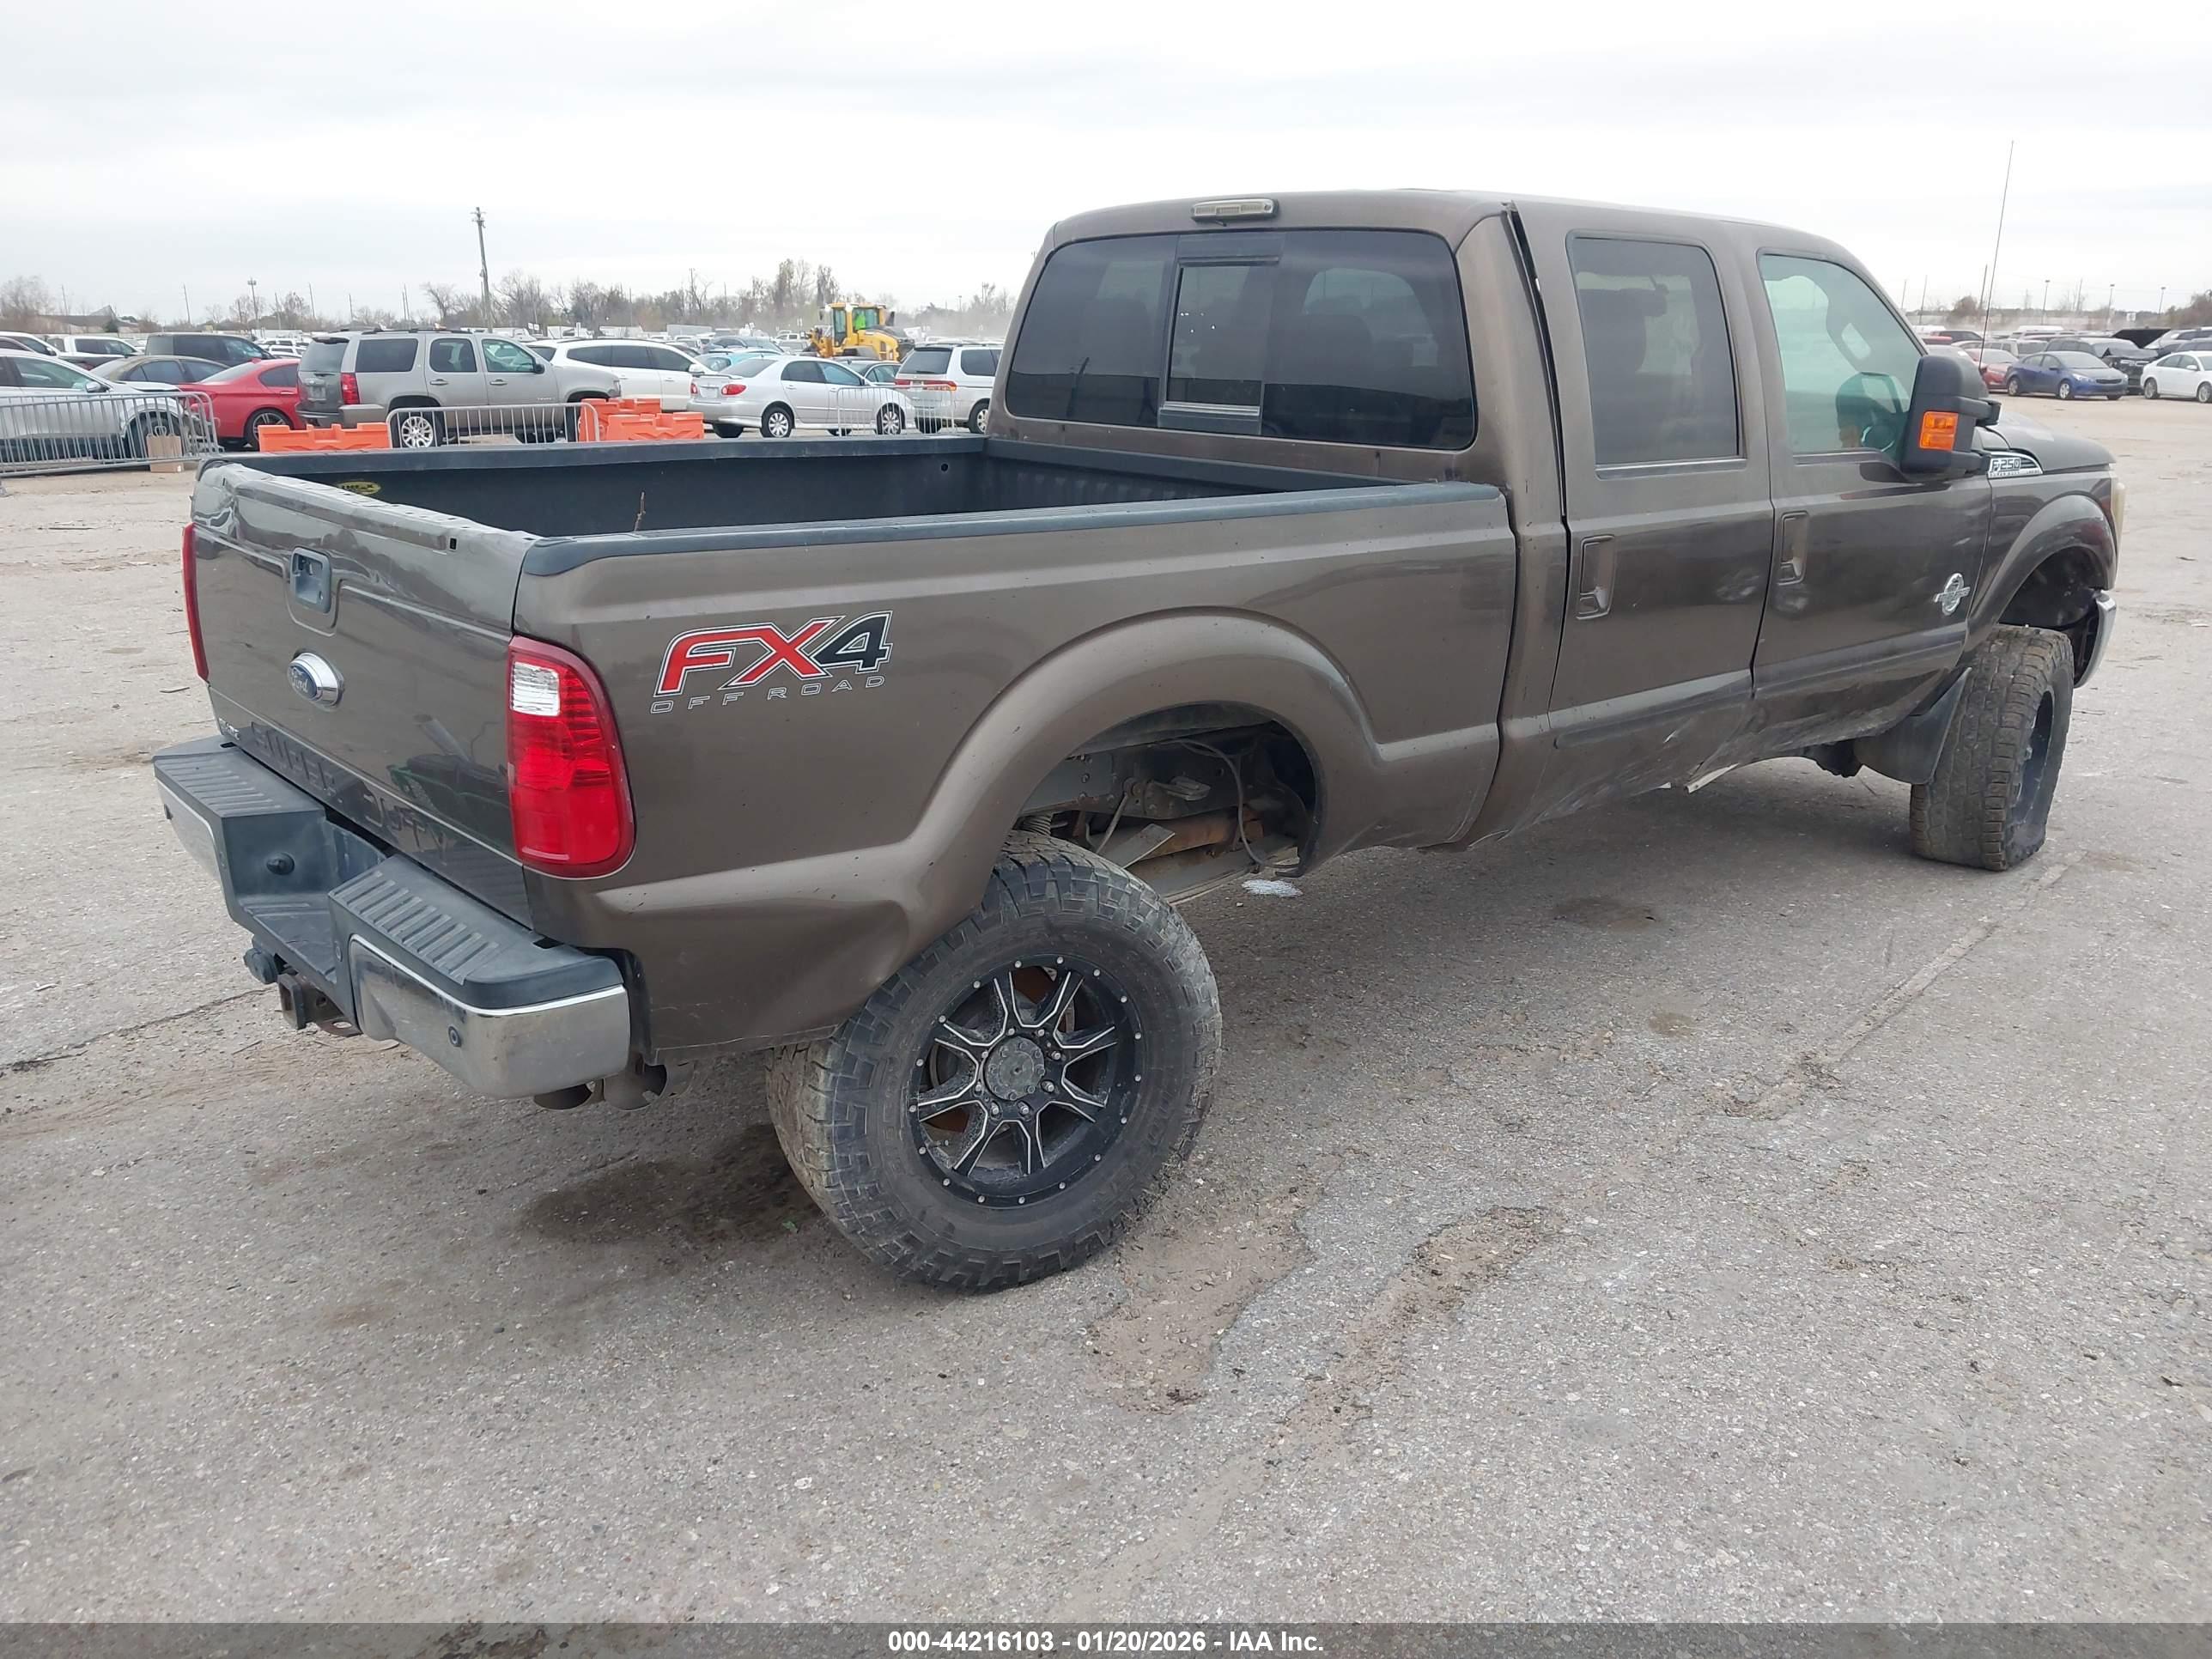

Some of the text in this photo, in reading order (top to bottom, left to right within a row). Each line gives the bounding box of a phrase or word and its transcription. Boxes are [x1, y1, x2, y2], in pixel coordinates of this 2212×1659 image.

[653, 611, 893, 697] FX4
[289, 665, 310, 695] Ford
[650, 674, 886, 714] OFF ROAD
